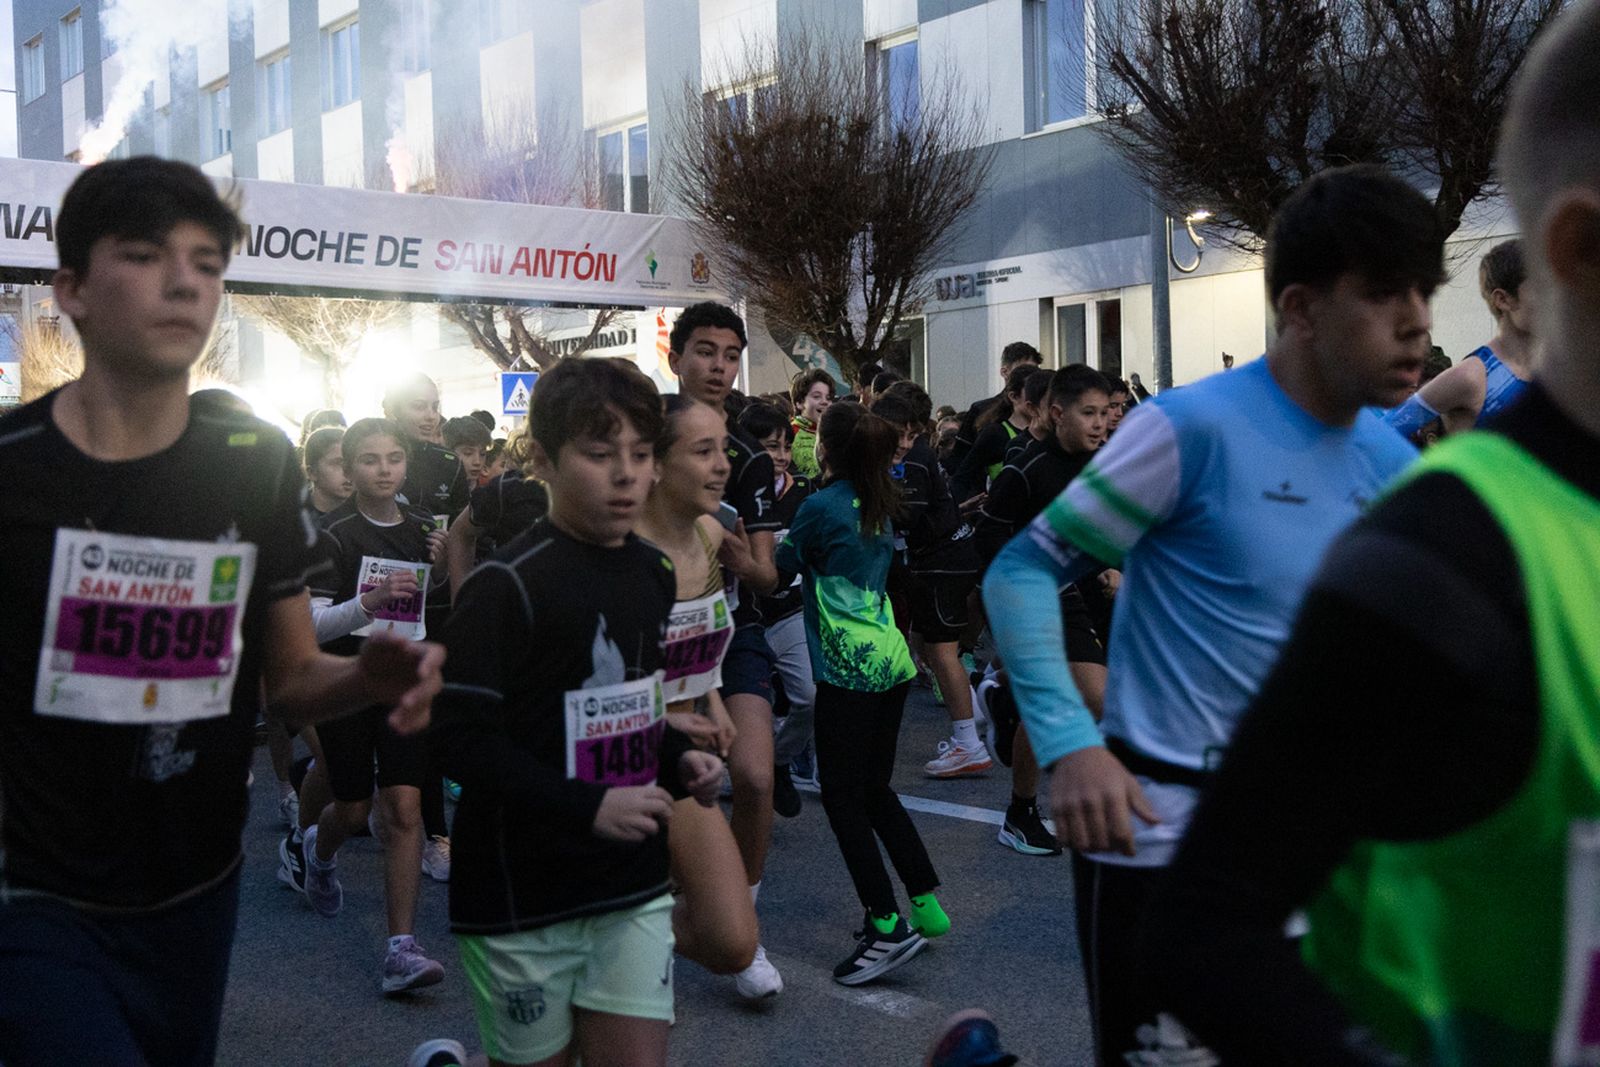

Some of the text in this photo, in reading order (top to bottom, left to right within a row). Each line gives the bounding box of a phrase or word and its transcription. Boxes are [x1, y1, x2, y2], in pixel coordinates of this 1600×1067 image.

[236, 224, 368, 265] NOCHE
[375, 235, 422, 268] DE
[434, 240, 504, 275] SAN
[508, 243, 617, 283] ANTÓN
[108, 558, 170, 578] NOCHE
[174, 563, 196, 581] DE
[79, 577, 121, 598] SAN
[127, 579, 195, 605] ANTÓN
[74, 604, 228, 660] 15699
[602, 697, 638, 715] NOCHE
[586, 720, 612, 737] SAN
